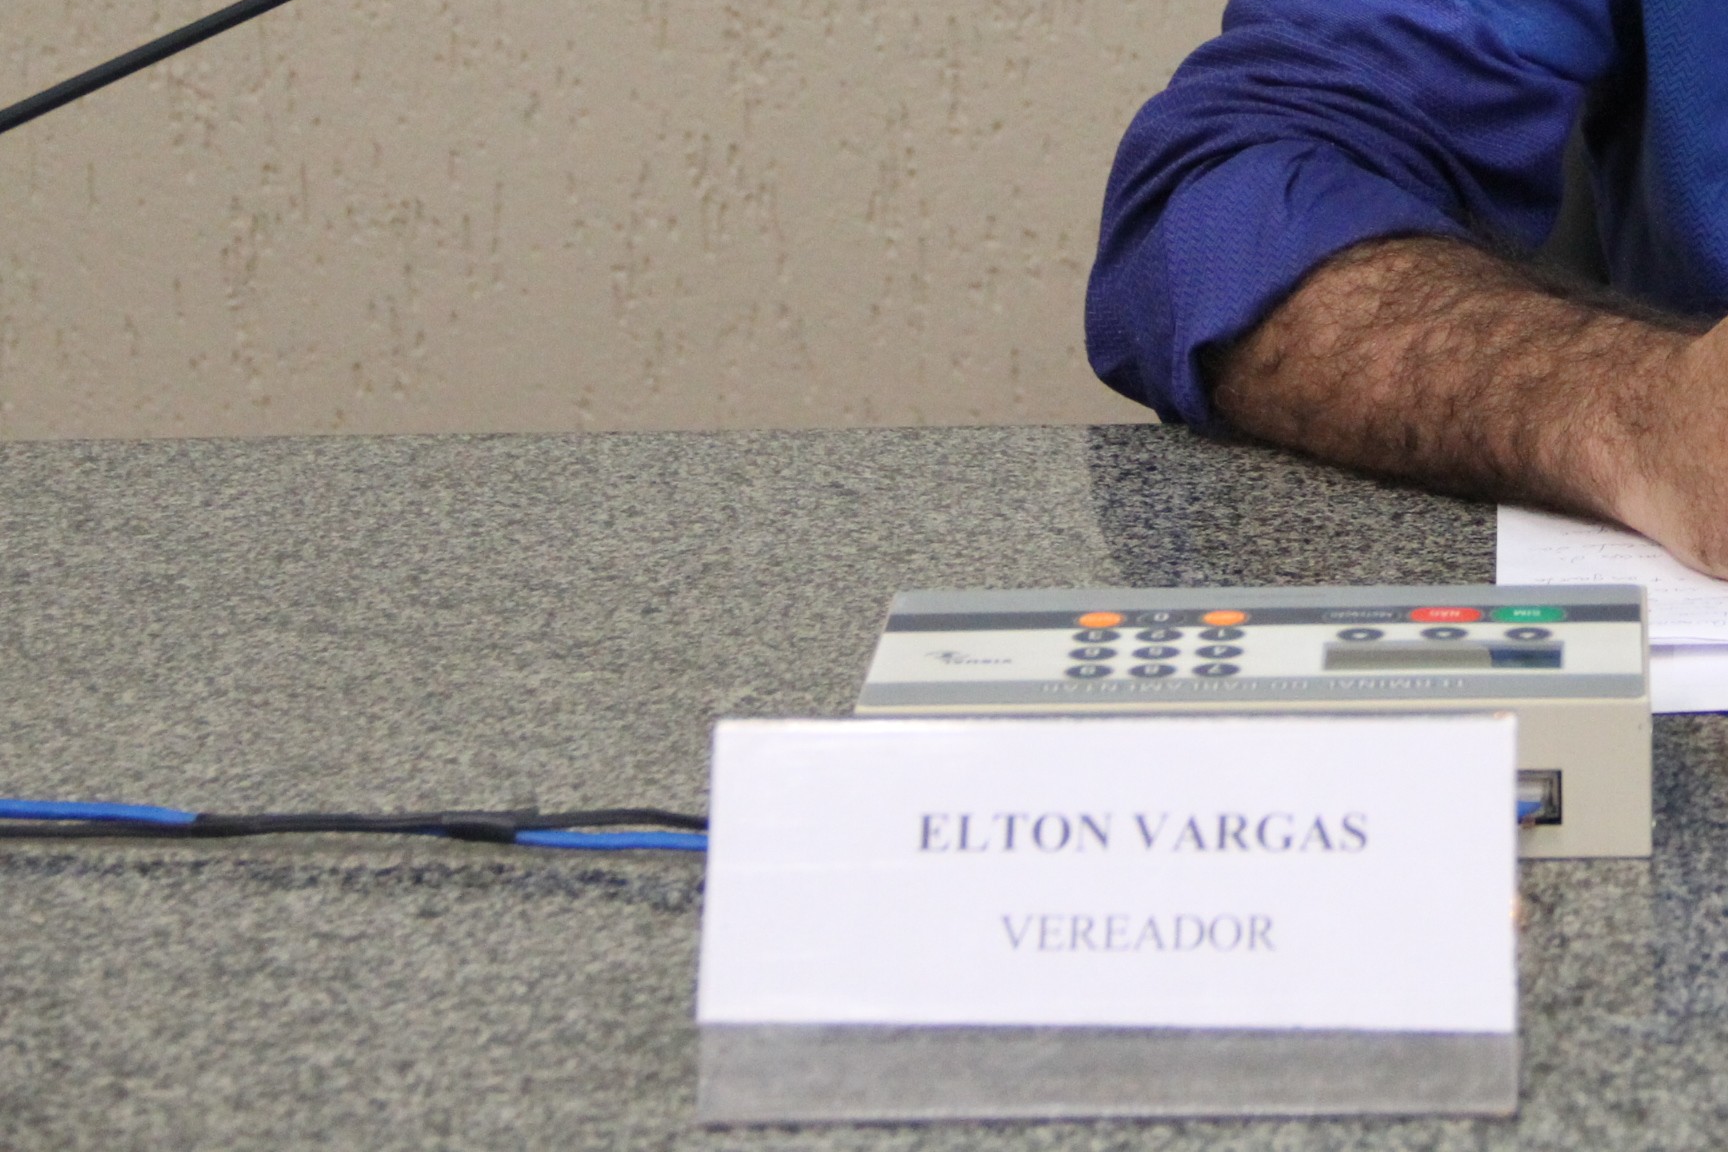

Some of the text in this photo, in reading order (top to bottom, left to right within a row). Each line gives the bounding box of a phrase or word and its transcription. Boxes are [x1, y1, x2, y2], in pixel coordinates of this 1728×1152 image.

[919, 811, 1370, 854] ELTON VARGAS
[1001, 912, 1279, 953] VEREADOR
